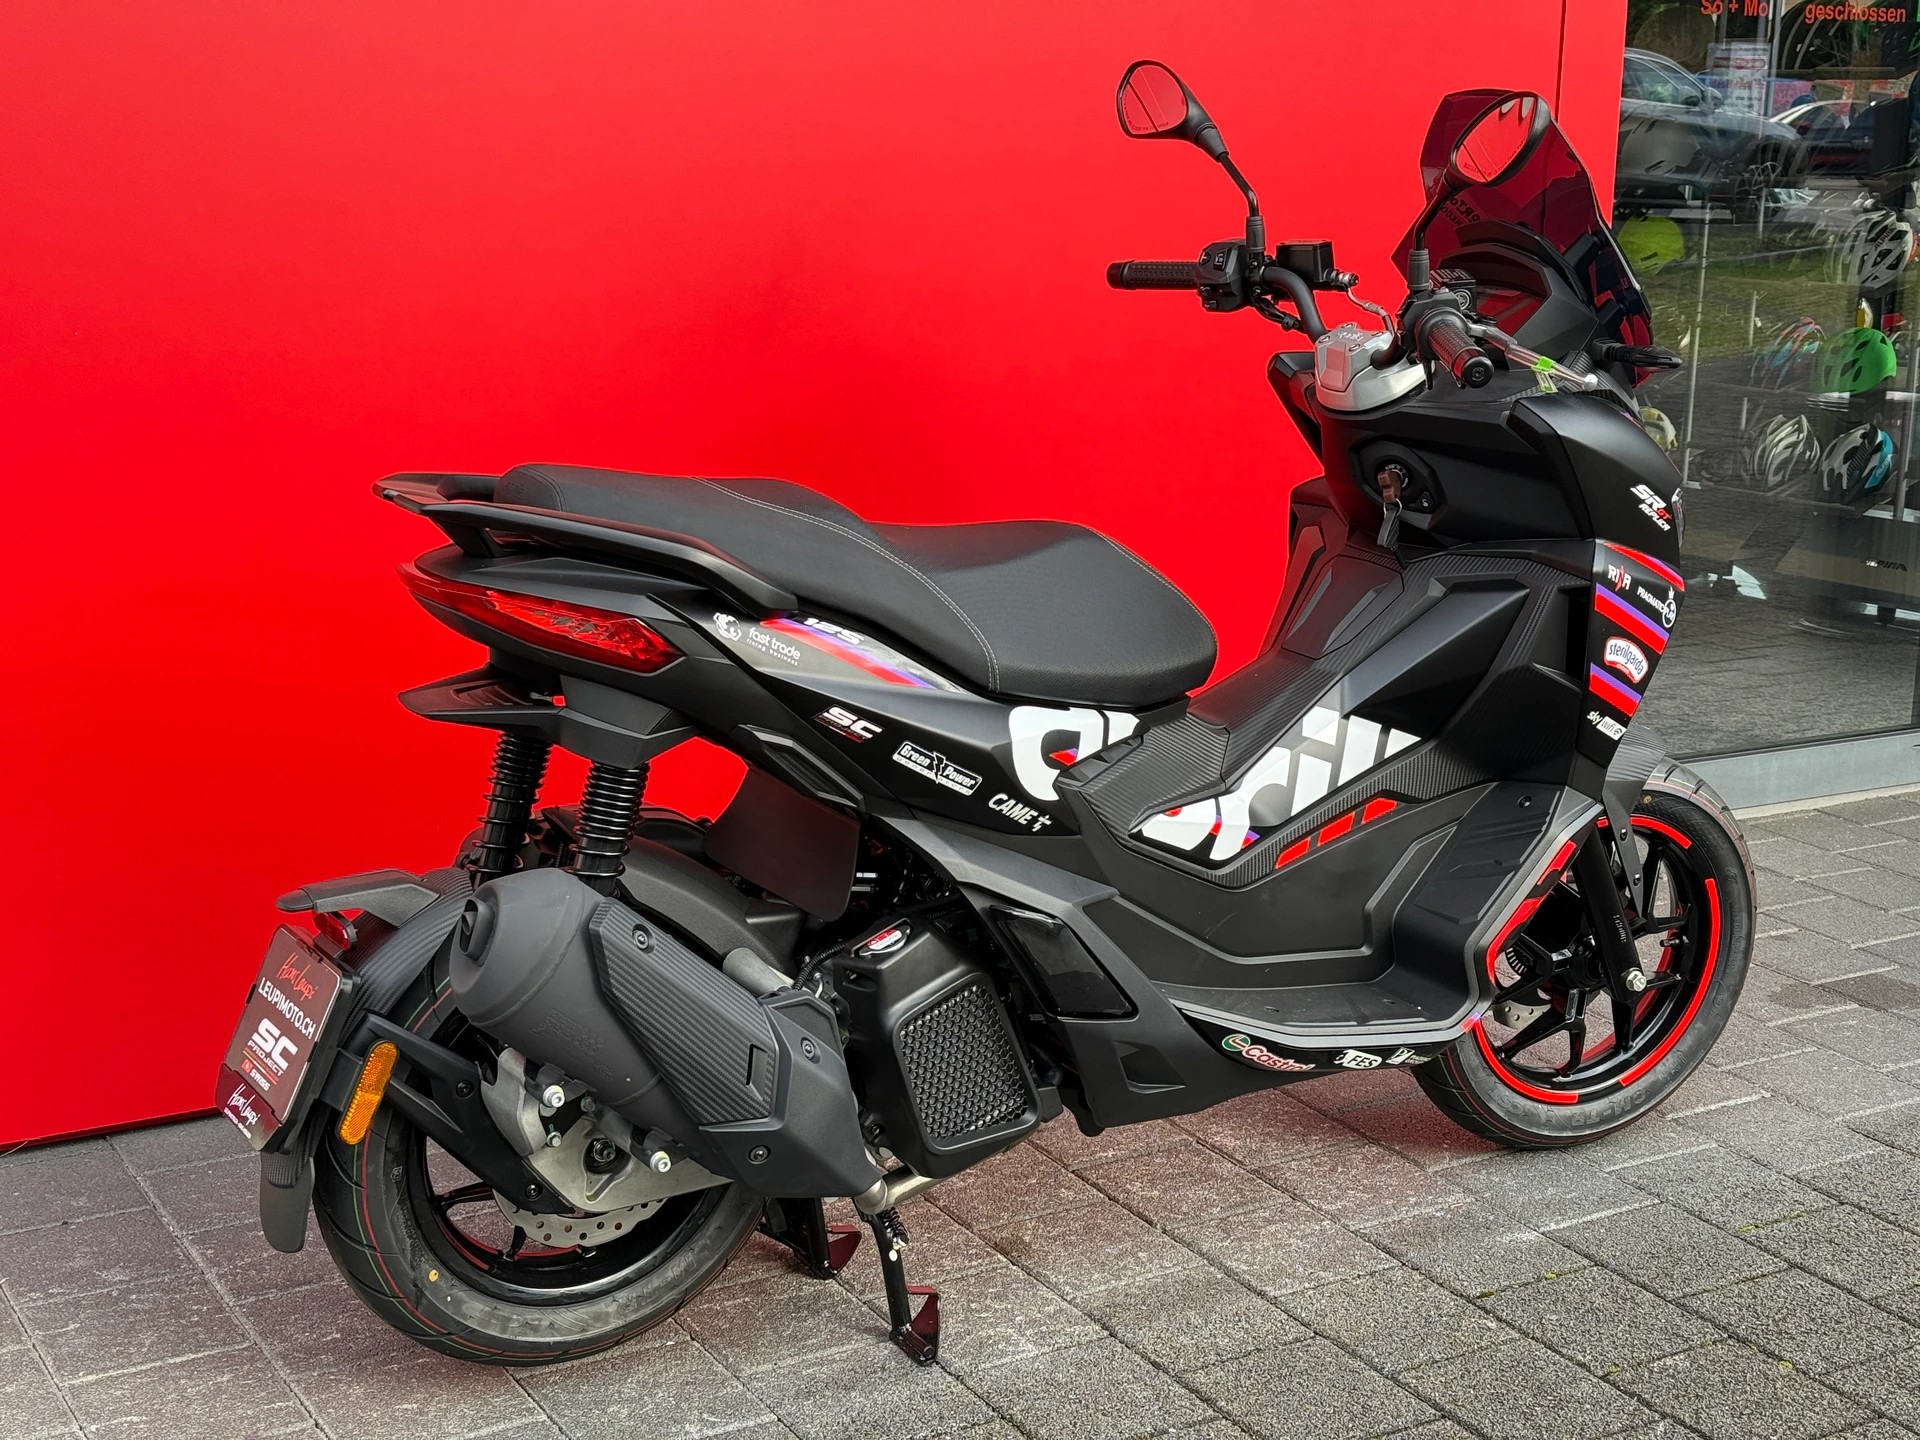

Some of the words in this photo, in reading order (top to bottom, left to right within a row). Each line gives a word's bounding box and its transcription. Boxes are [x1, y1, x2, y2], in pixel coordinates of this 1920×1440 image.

[1700, 0, 1723, 15] So
[1743, 0, 1769, 17] Mo
[1804, 1, 1907, 23] geschlossen
[1630, 483, 1667, 512] SR
[1656, 507, 1672, 521] GT
[1639, 502, 1671, 532] REPLICA
[1637, 586, 1664, 613] PRAGMATIC
[748, 627, 770, 647] fast
[771, 637, 801, 660] trade
[803, 617, 865, 646] 125
[1608, 642, 1644, 675] sterilgarda
[822, 706, 883, 739] SC
[1587, 710, 1602, 726] sky
[1602, 718, 1615, 734] wifi
[900, 744, 931, 768] Green
[943, 765, 976, 788] Power
[988, 793, 1038, 825] CAME
[257, 976, 317, 1040] LEUPIMOTO.CH
[247, 1039, 284, 1077] PROJECT
[251, 1017, 299, 1072] SC
[249, 1068, 271, 1092] SWISS
